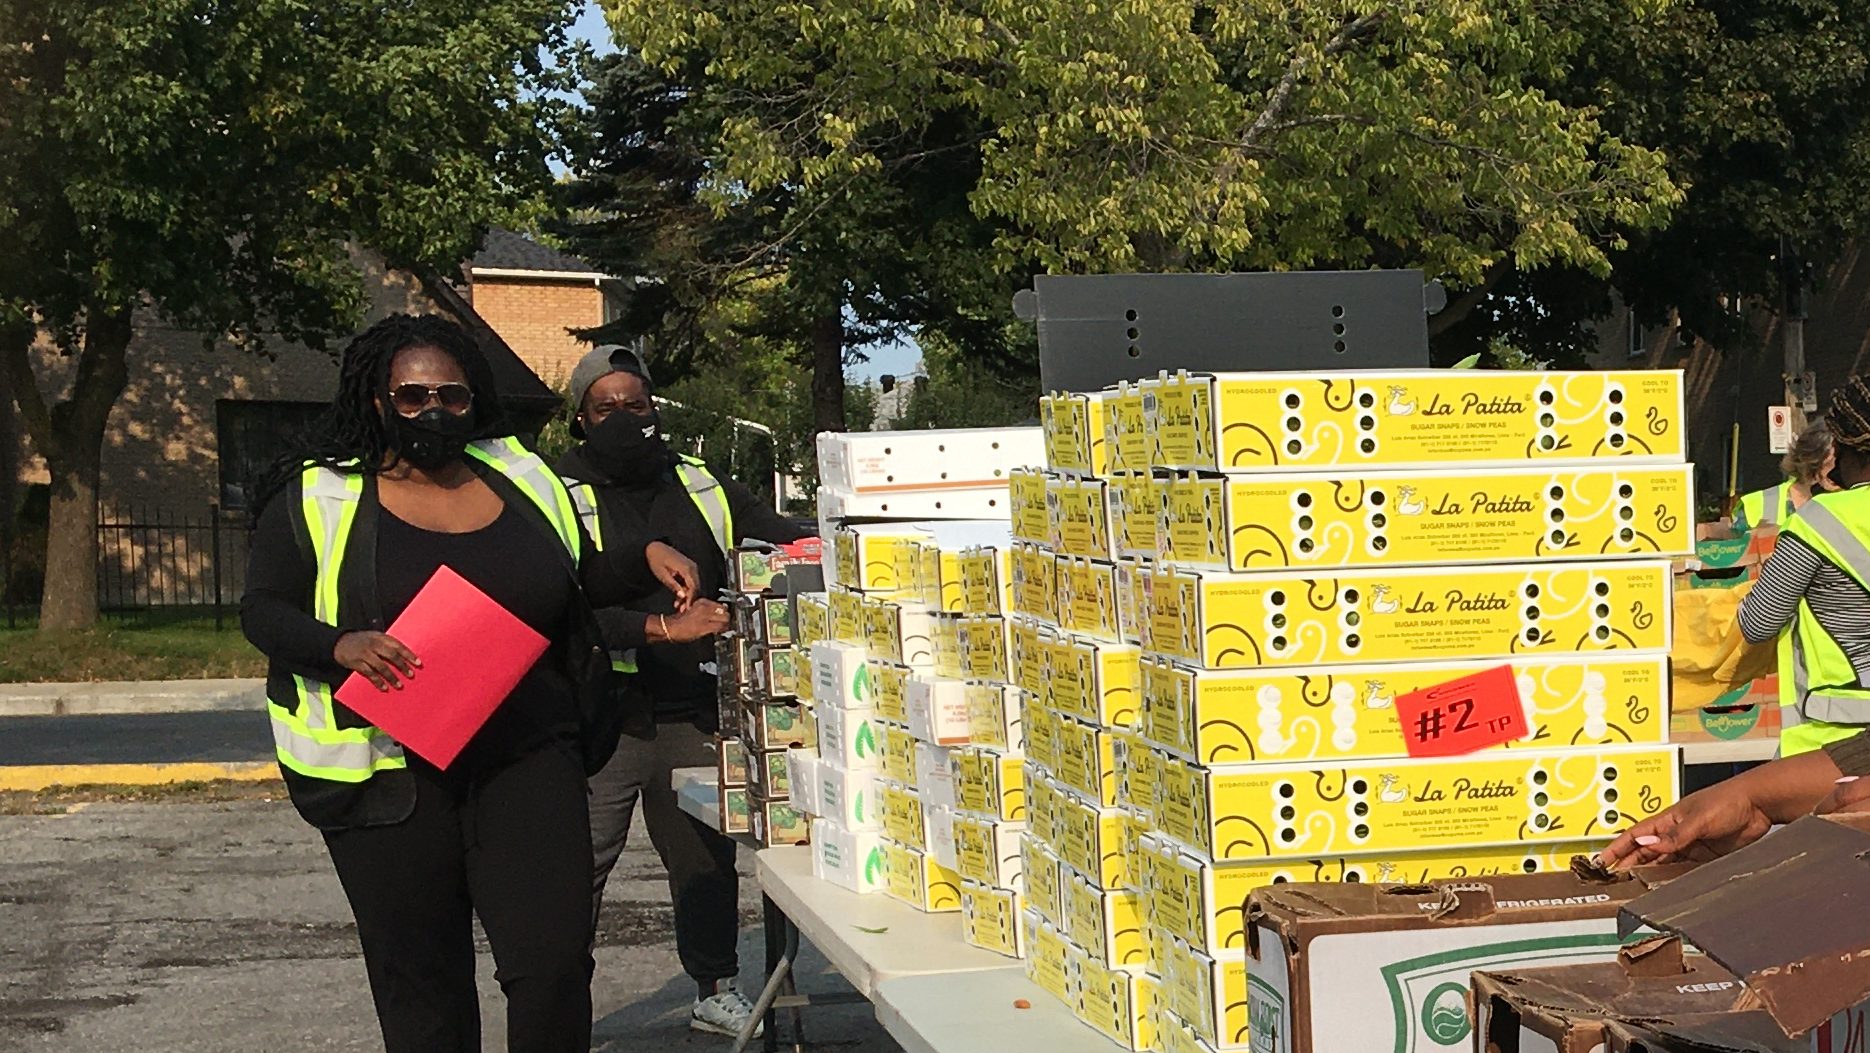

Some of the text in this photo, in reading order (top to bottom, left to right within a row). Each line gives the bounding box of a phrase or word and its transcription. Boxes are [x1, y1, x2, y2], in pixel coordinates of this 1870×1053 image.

[1422, 392, 1527, 416] La Patita
[1410, 421, 1507, 431] SUGAR SNAPS SNOW PEAS
[1431, 491, 1536, 516] La Patita
[1420, 520, 1516, 530] SUGAR SNAPS SNOW PEAS
[1405, 589, 1511, 614] La Patita
[1394, 617, 1491, 628] SUGAR SNAPS SNOW PEAS
[1414, 698, 1512, 743] #2 TP
[1413, 777, 1519, 803] La Patita
[1402, 805, 1499, 817] SUGAR SNAPS SNOW PEAS
[1496, 893, 1610, 910] FRIGERATED
[1676, 979, 1734, 995] KEEP
